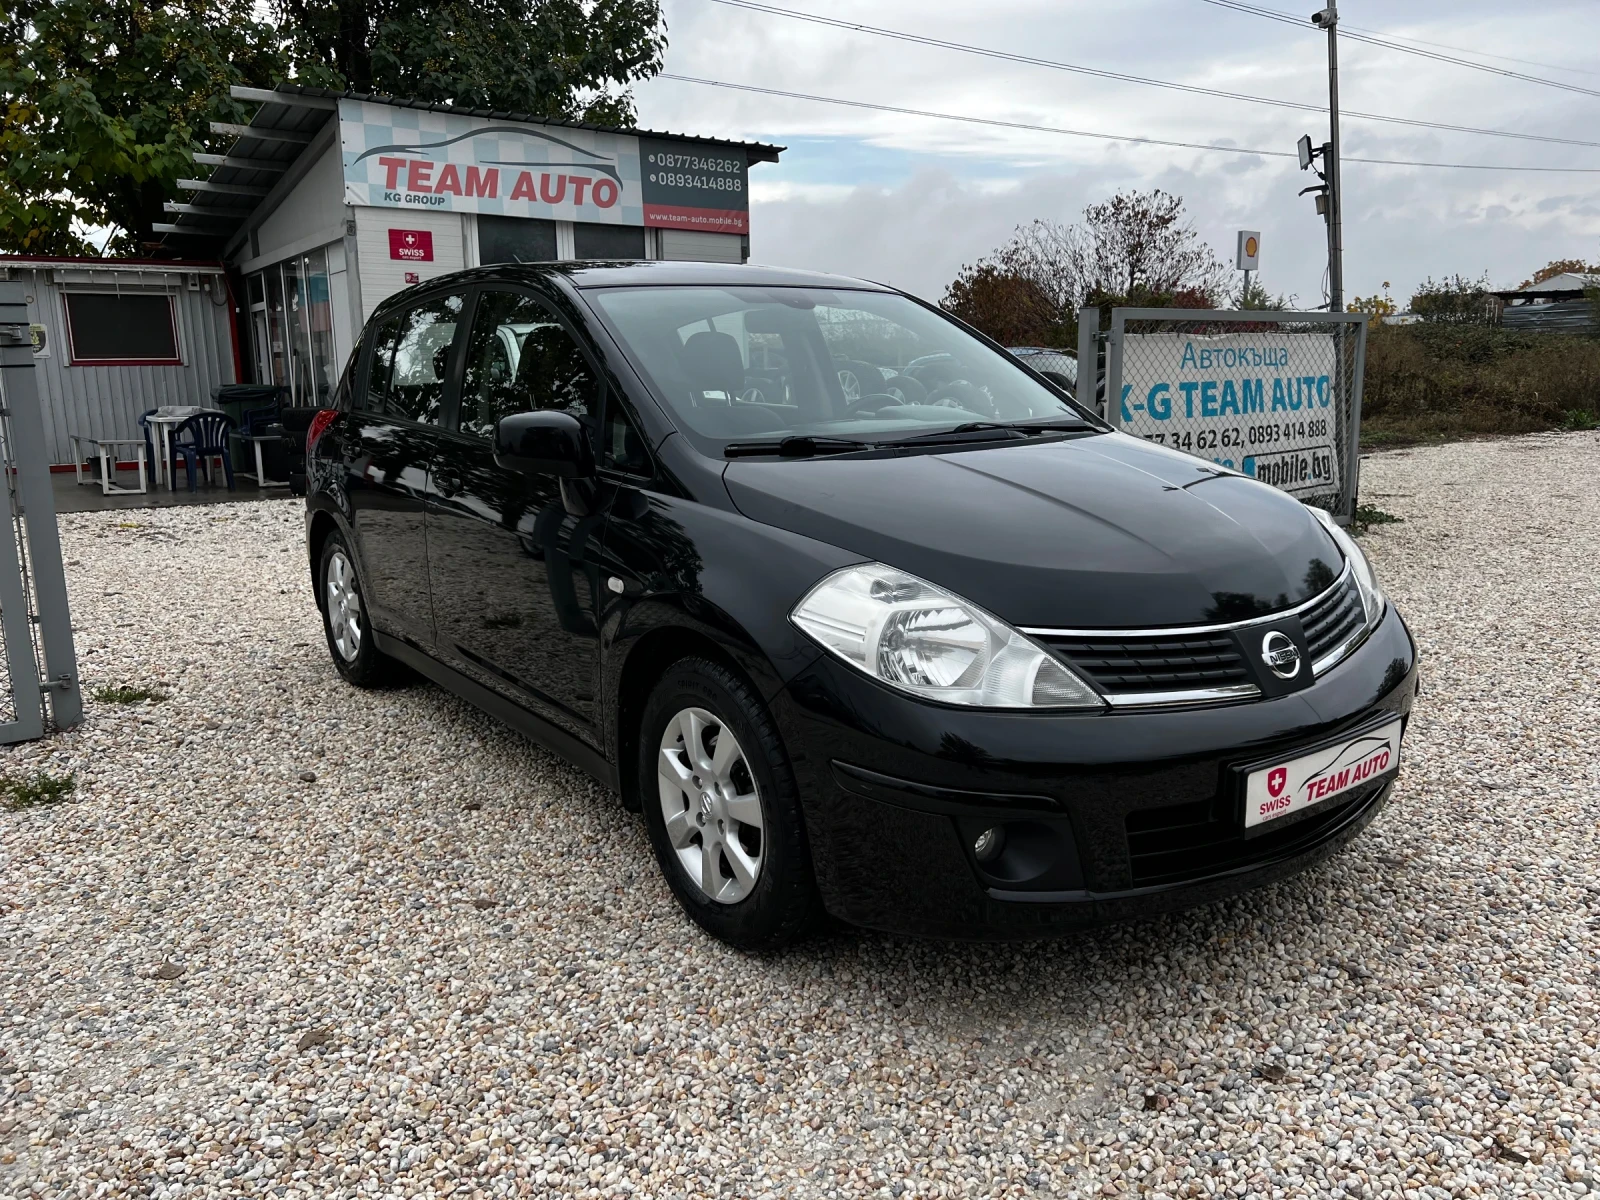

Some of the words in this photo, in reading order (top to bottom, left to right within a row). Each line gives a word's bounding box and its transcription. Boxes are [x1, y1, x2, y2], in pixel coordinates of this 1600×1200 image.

[657, 153, 741, 174] 0877346262
[379, 156, 499, 199] TEAM
[510, 171, 618, 209] AUTO
[658, 172, 742, 192] 0893414888
[384, 192, 402, 203] KG
[405, 193, 446, 206] GROUP
[649, 213, 743, 228] www.team-auto.mobile.bg
[398, 248, 425, 257] SWISS
[1181, 341, 1289, 371] Автокъща
[1179, 379, 1265, 418] TEAM
[1271, 375, 1331, 412] AUTO
[1196, 429, 1218, 450] 62
[1221, 427, 1245, 449] 62,
[1249, 424, 1280, 445] 0893
[1283, 421, 1306, 441] 414
[1308, 419, 1327, 438] 888
[1257, 451, 1331, 486] mobile.bg
[1307, 768, 1350, 802] TEAM
[1351, 750, 1389, 784] AUTO
[1259, 794, 1291, 815] SWISS
